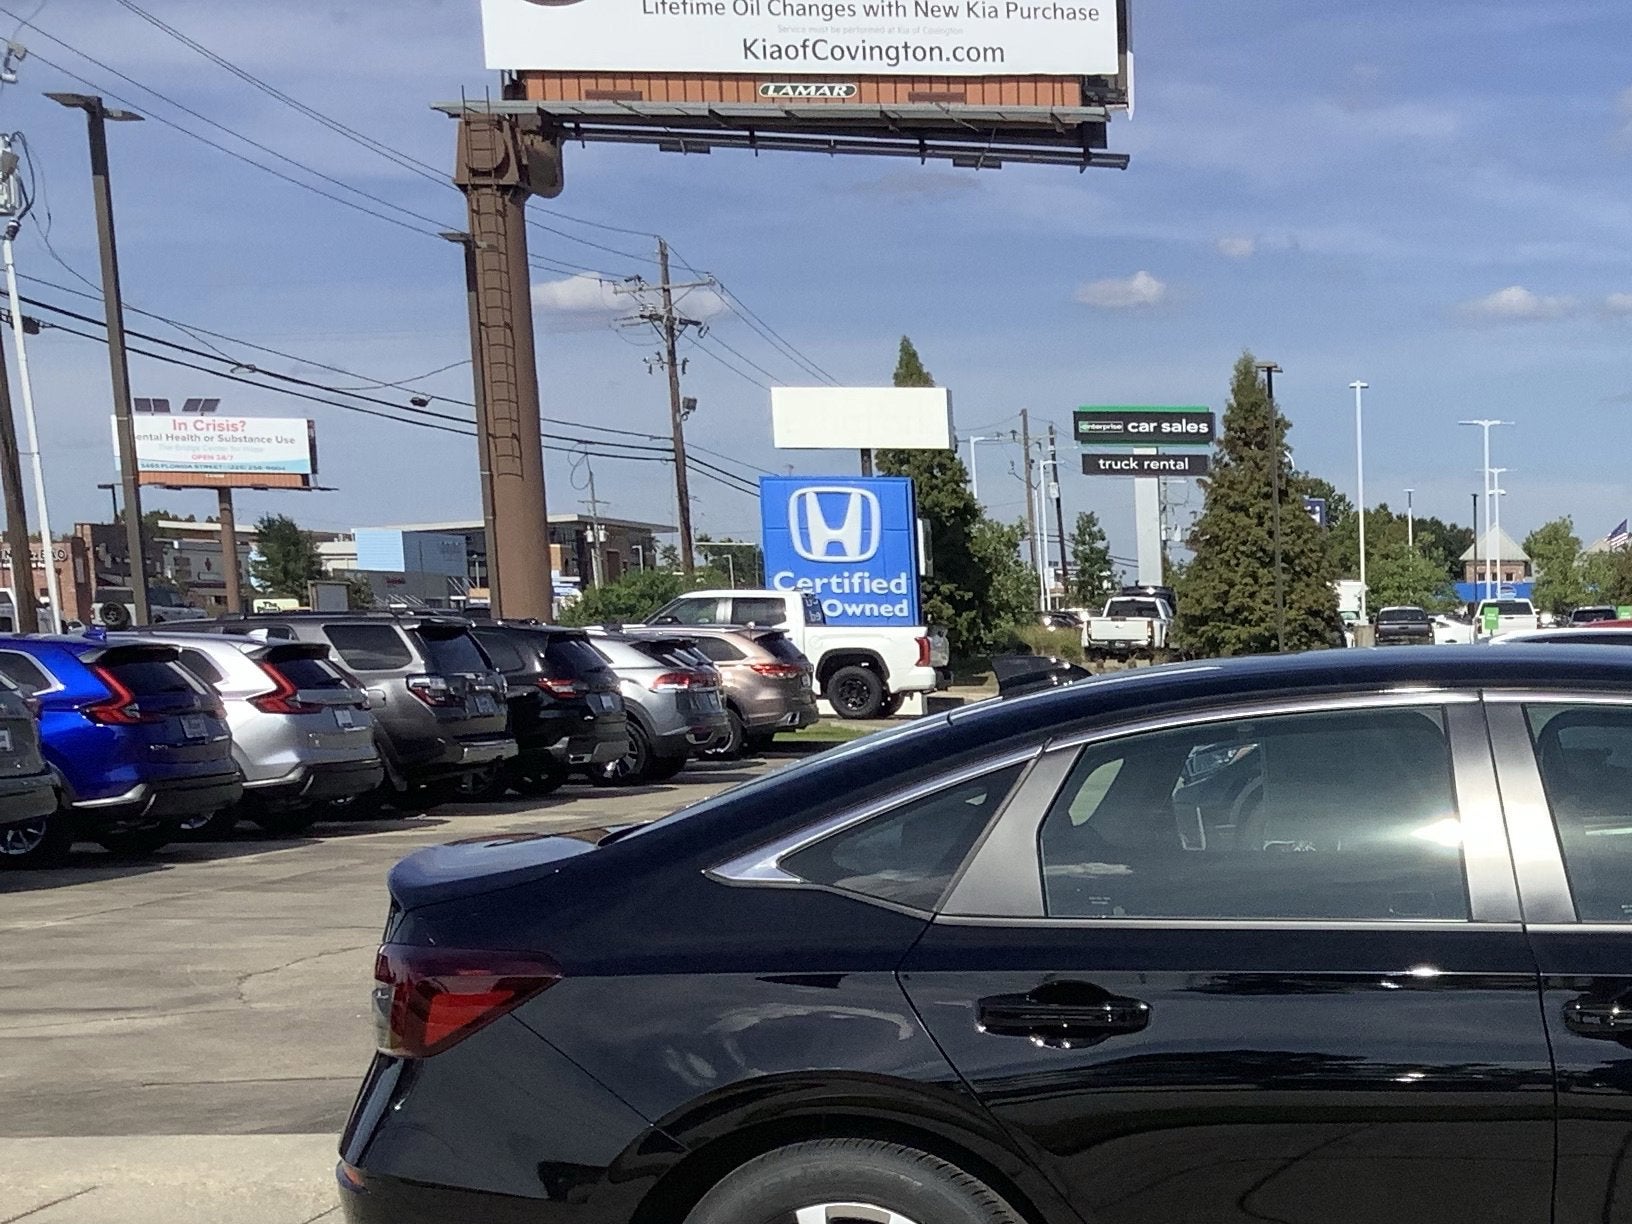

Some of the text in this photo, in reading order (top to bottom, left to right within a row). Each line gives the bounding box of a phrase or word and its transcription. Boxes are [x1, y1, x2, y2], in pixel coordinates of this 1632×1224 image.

[642, 0, 1100, 21] Lifetime Oil Changes with New Kia Purchase
[743, 38, 1005, 66] KiaofCovington.com
[767, 85, 848, 96] LAMAR
[172, 419, 247, 432] In Crisis?
[1127, 422, 1157, 433] car
[1161, 418, 1209, 433] sales
[165, 433, 201, 442] Health
[204, 435, 214, 443] or
[217, 434, 273, 444] Substance
[275, 436, 296, 445] Use
[1098, 457, 1189, 470] truck rental
[773, 571, 907, 595] Certified
[823, 599, 909, 618] Owned
